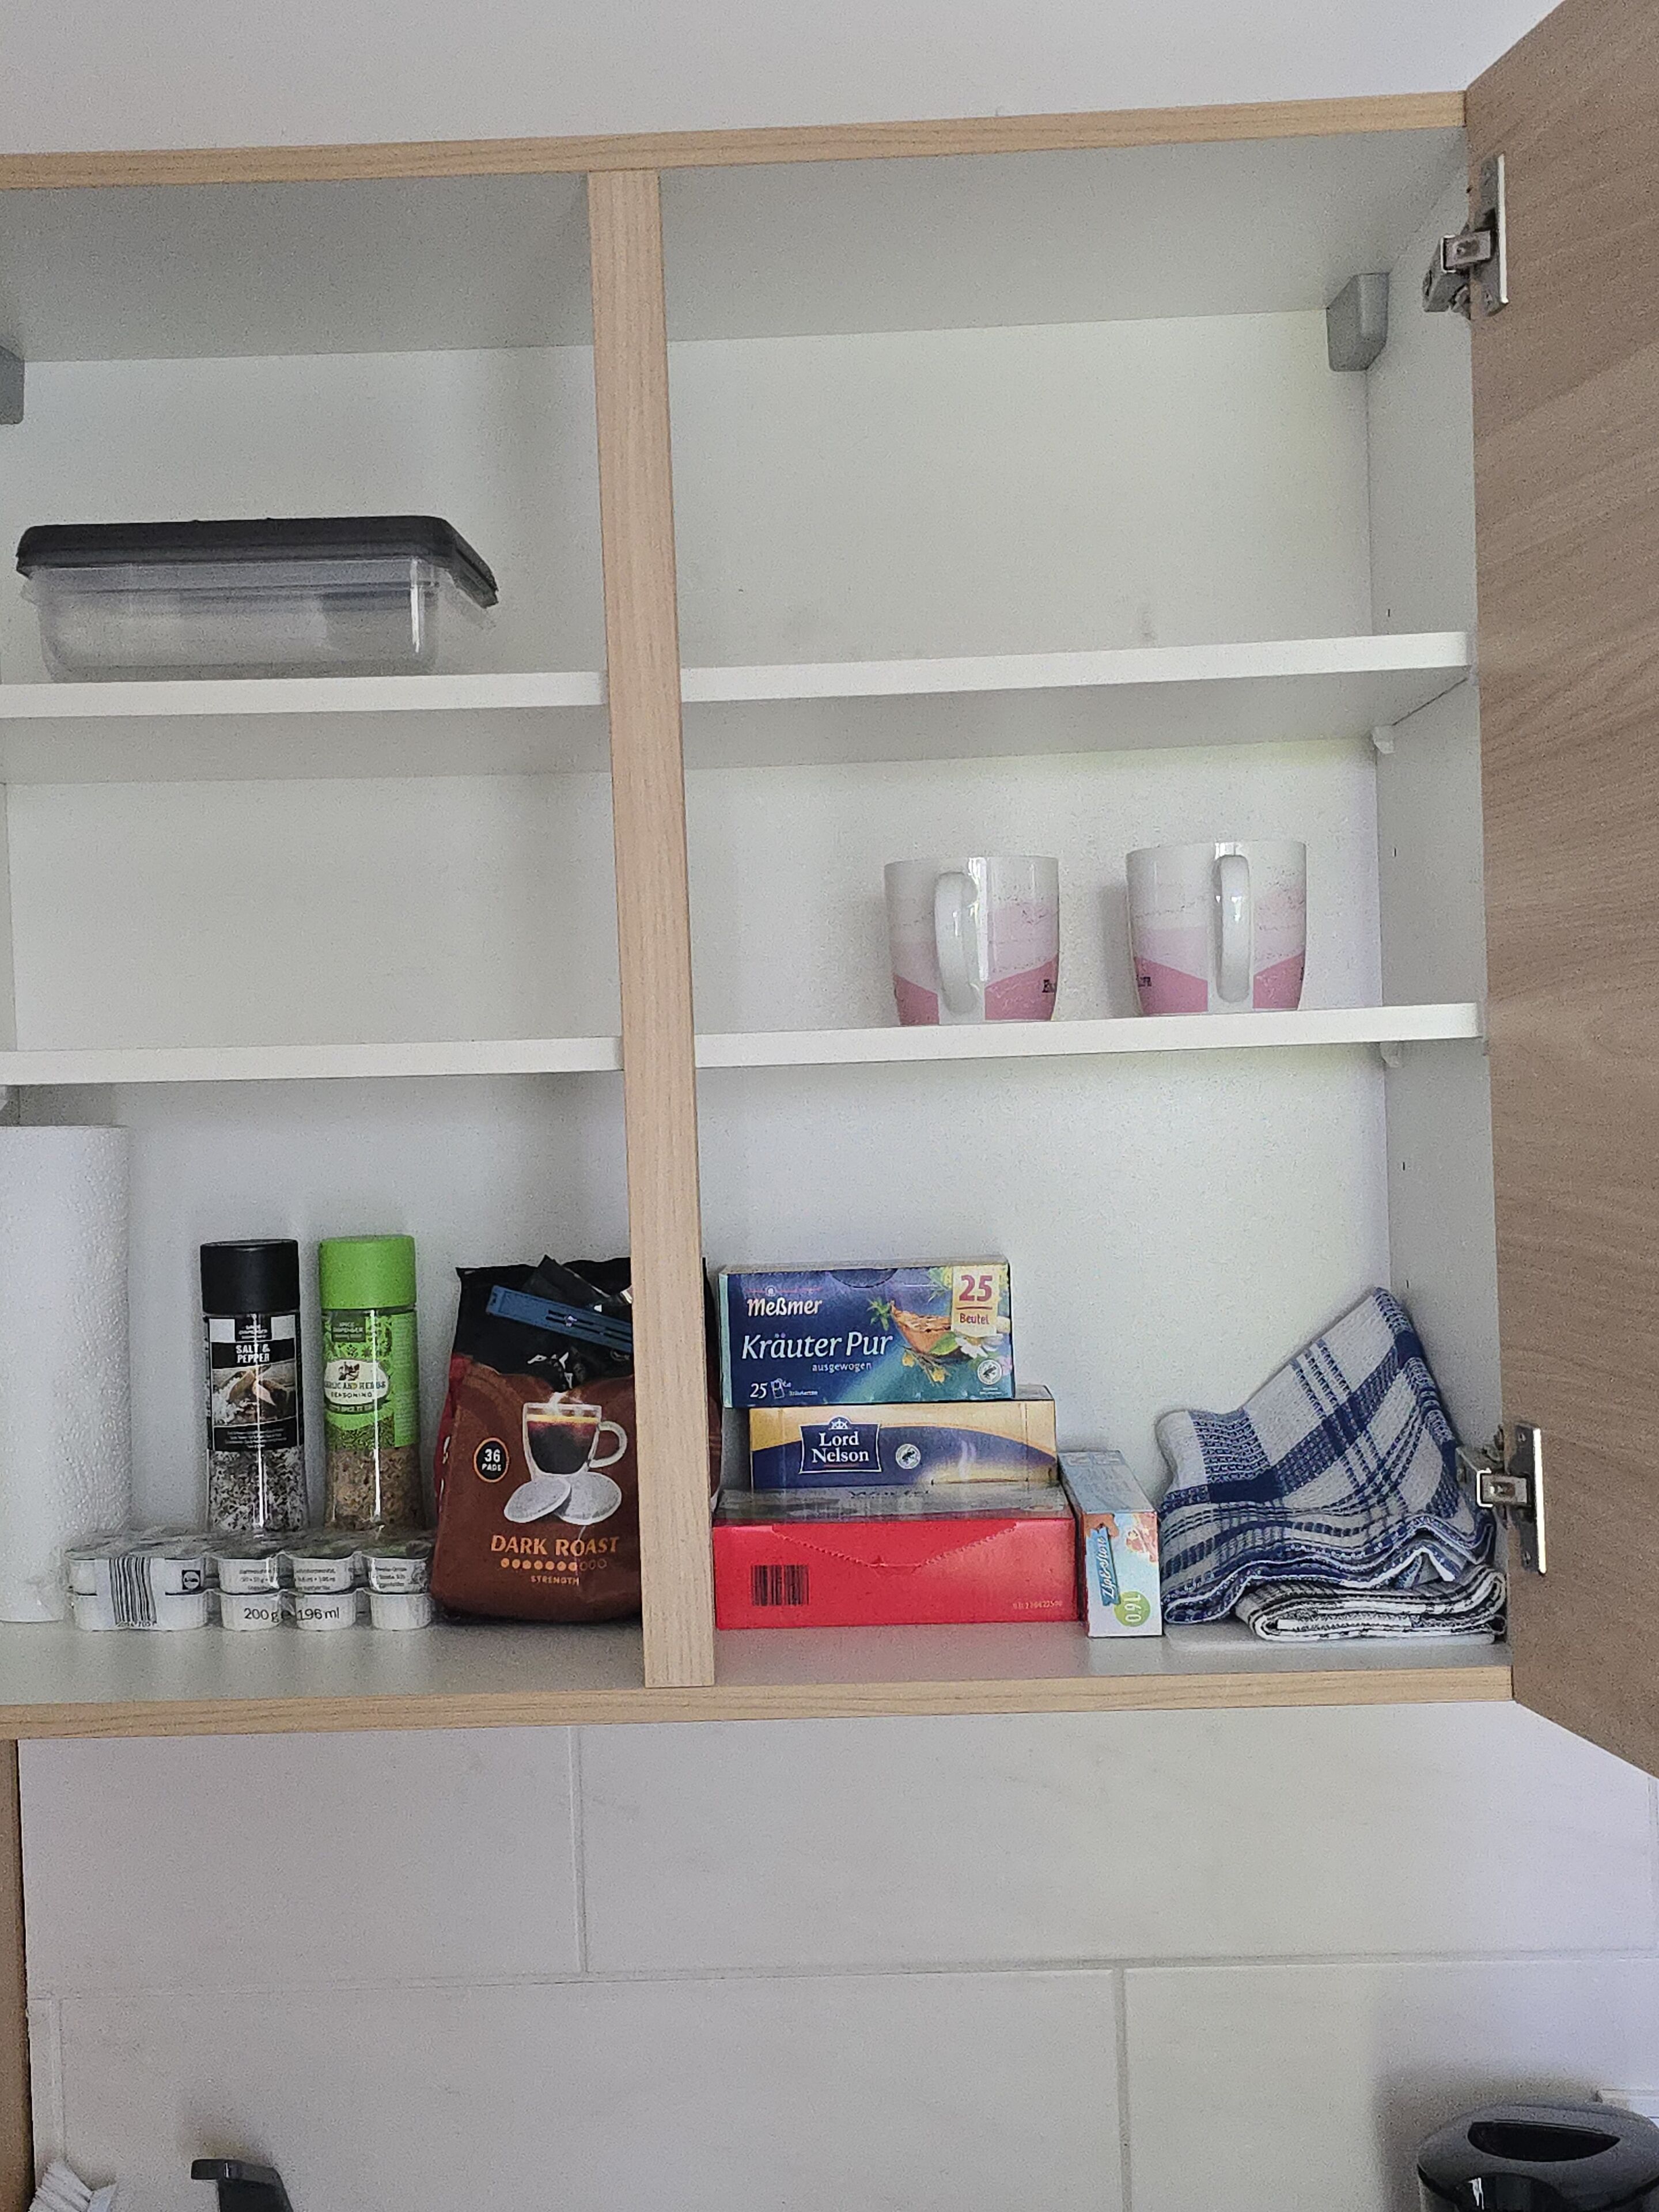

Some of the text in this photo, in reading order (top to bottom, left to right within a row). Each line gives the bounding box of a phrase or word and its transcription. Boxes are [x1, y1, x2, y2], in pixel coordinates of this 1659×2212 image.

[959, 1274, 993, 1302] 25
[747, 1297, 823, 1317] Meßmer
[959, 1313, 990, 1325] Beutel
[235, 1343, 271, 1354] SALT &
[741, 1331, 893, 1359] Kräuter Pur
[236, 1353, 270, 1363] PEPPER
[812, 1362, 872, 1373] ausgewogen
[749, 1382, 768, 1399] 25
[818, 1431, 860, 1447] Lord
[484, 1448, 501, 1463] 36
[810, 1448, 870, 1464] Nelson
[482, 1463, 502, 1471] PADS
[491, 1535, 620, 1556] DARK ROAST
[530, 1575, 579, 1586] STRENGTH
[244, 1607, 269, 1620] 200
[298, 1608, 322, 1621] 196
[324, 1607, 340, 1619] ml
